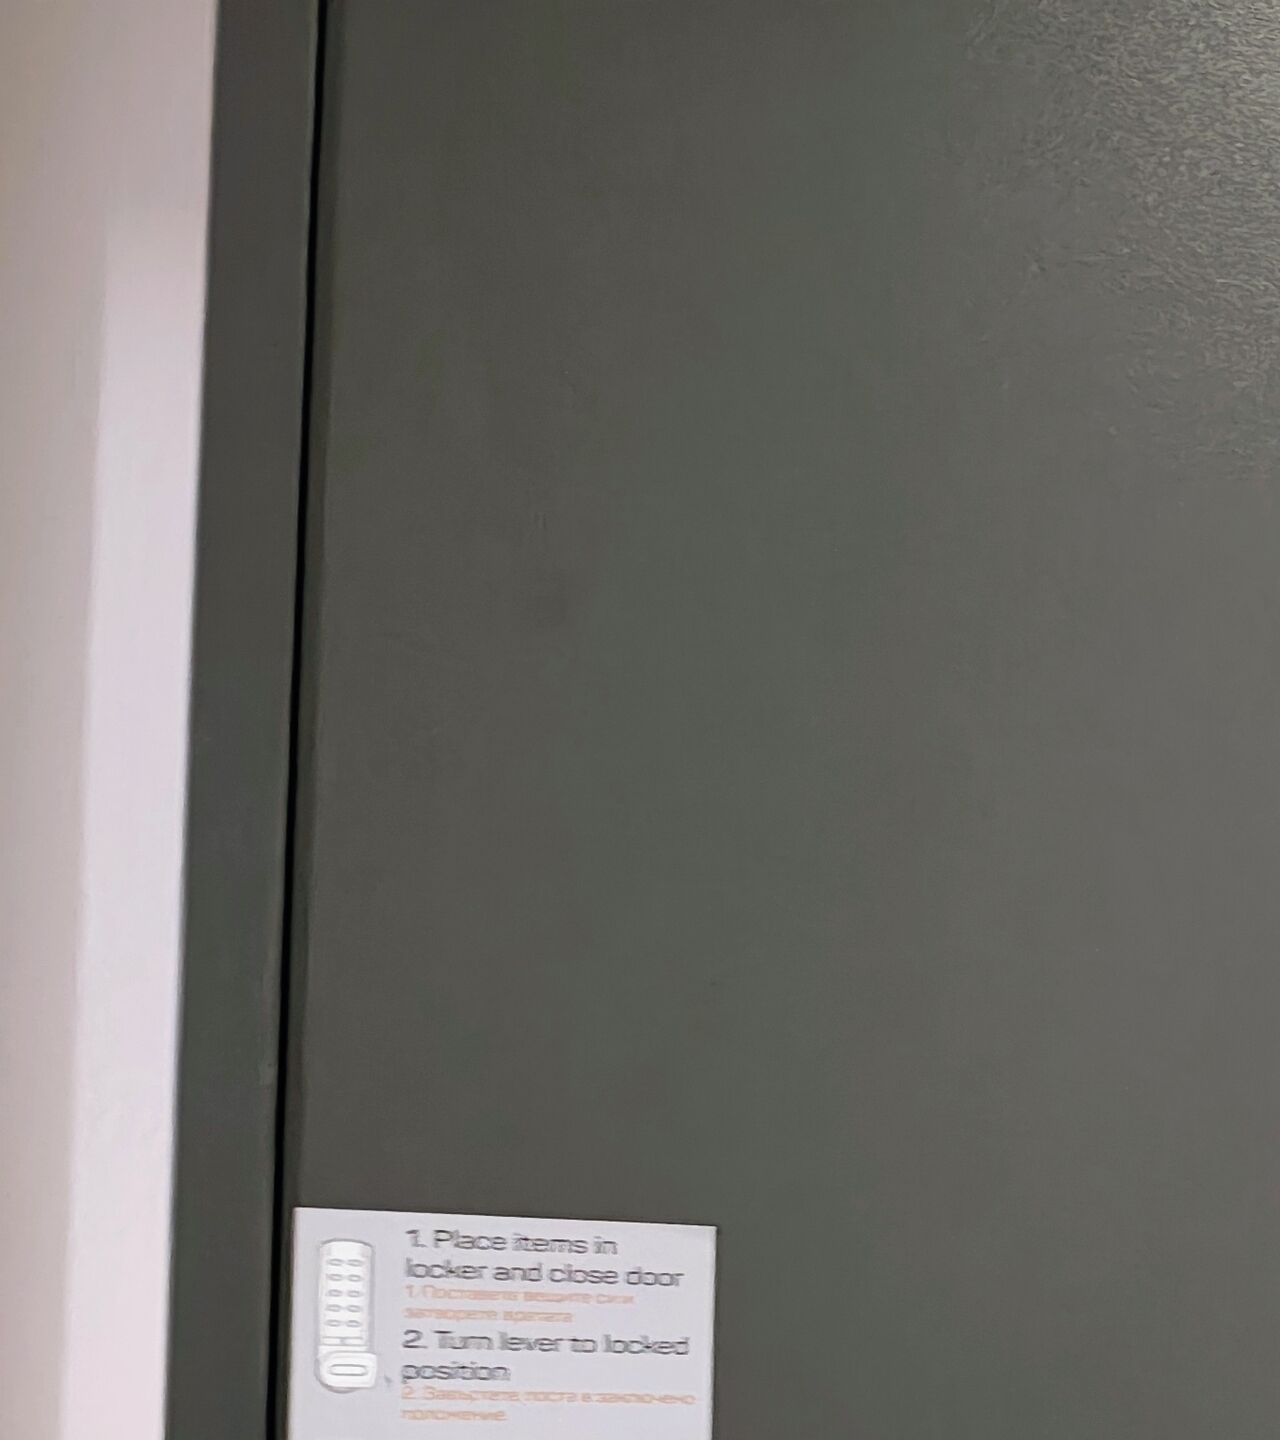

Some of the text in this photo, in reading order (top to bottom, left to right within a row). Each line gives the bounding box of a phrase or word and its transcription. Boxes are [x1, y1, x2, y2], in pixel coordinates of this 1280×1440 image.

[433, 1229, 507, 1250] Place
[511, 1232, 589, 1254] items
[593, 1236, 618, 1255] in
[405, 1257, 685, 1287] locker and close door
[402, 1329, 690, 1356] 2. Turn lever to locked
[401, 1361, 511, 1384] position
